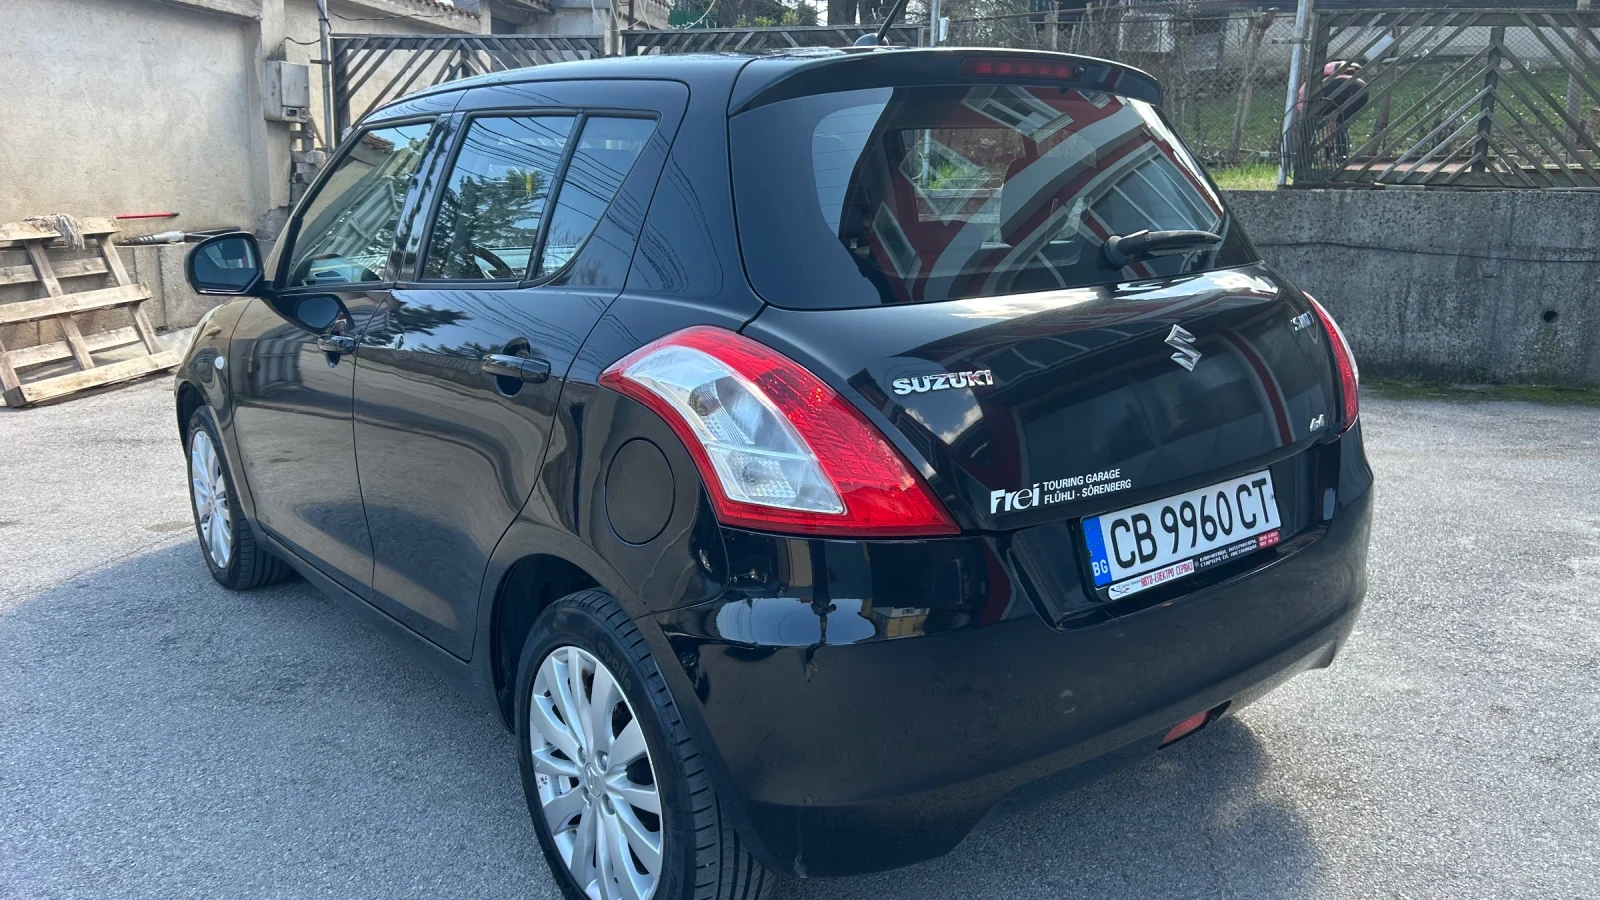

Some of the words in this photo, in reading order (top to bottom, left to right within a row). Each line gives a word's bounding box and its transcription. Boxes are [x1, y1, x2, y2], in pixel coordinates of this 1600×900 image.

[892, 369, 994, 396] SUZUKI
[1043, 475, 1084, 492] TOURING
[1085, 468, 1121, 485] GARAGE
[1044, 489, 1075, 505] FLÜHLI
[1081, 478, 1132, 498] SÖRENBERG
[990, 482, 1040, 514] Frei
[1110, 512, 1157, 569] CB
[1160, 490, 1233, 555] 9960
[1235, 477, 1270, 530] CT
[1091, 559, 1109, 577] BG
[598, 641, 632, 692] apollo
